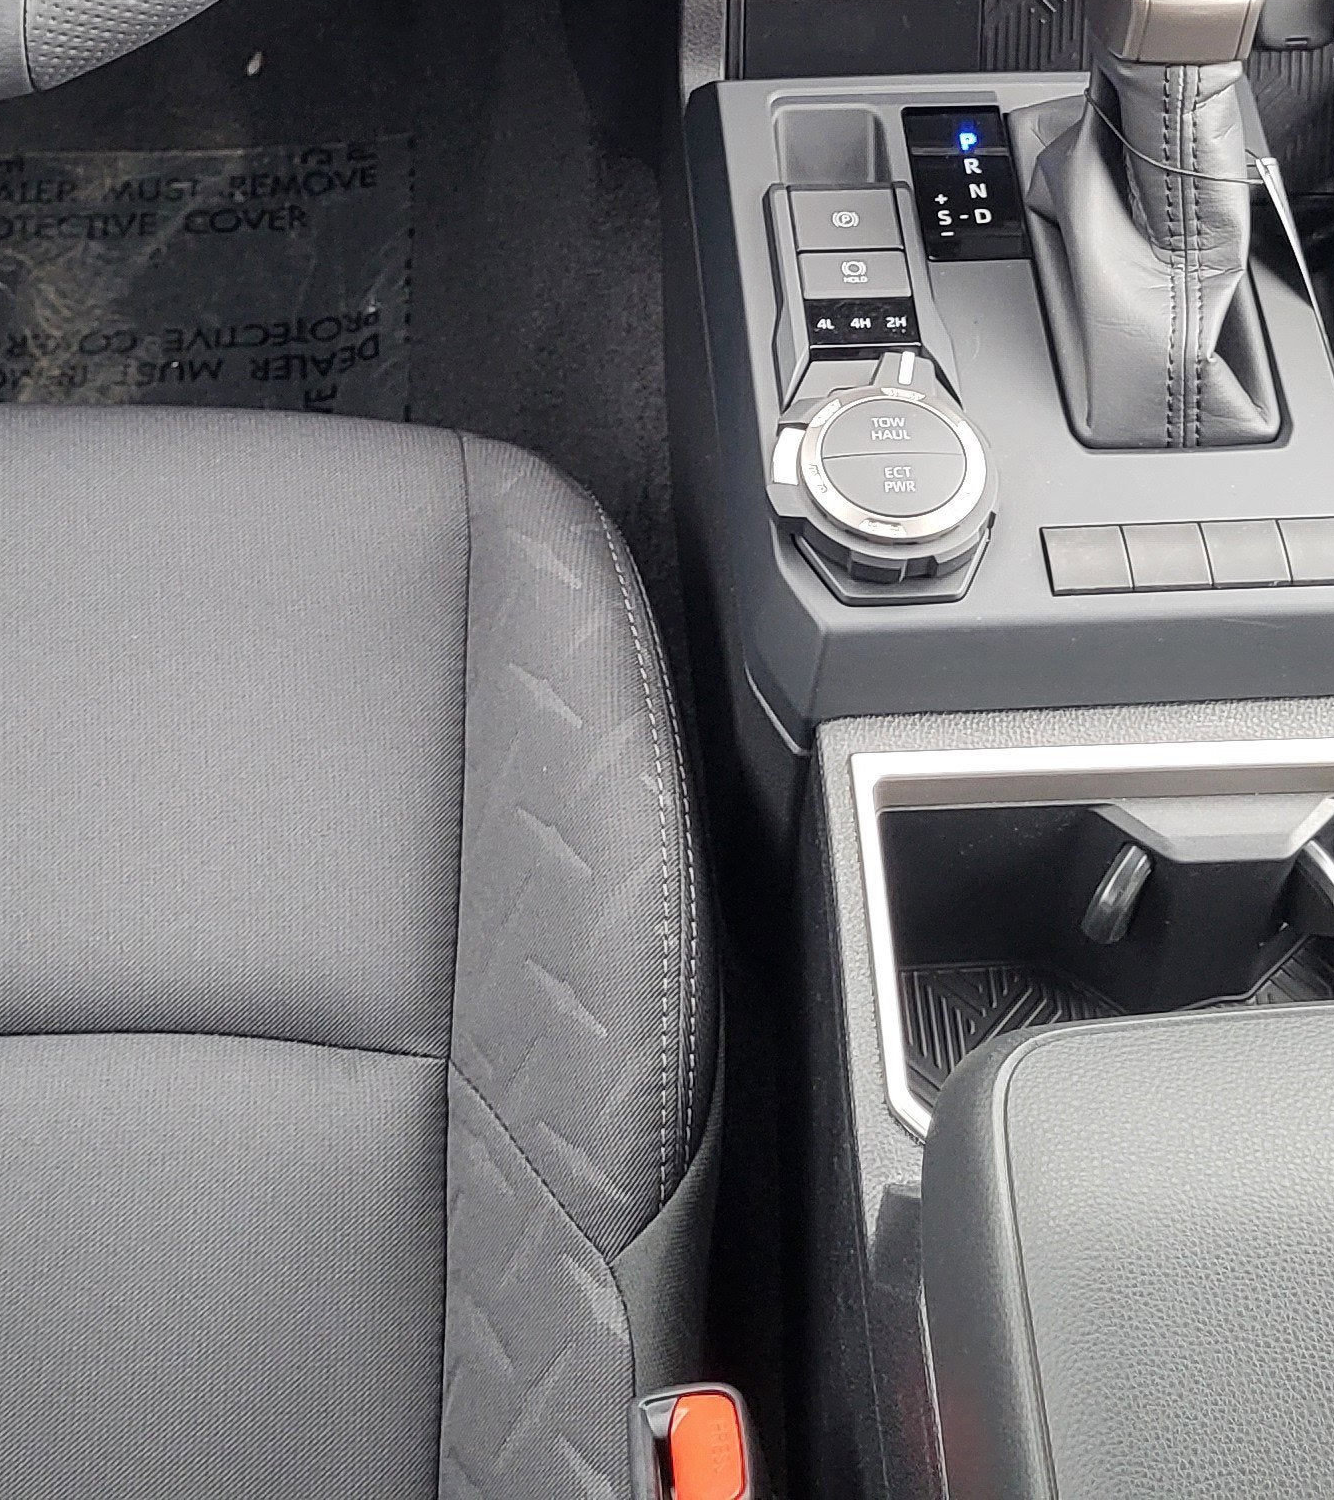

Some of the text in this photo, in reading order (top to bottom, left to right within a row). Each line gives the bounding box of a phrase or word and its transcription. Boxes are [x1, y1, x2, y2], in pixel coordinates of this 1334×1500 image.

[958, 131, 978, 152] P
[963, 157, 983, 175] R
[222, 164, 379, 200] REMOVE
[968, 182, 988, 199] N
[181, 203, 310, 237] COVER
[936, 207, 992, 226] S D
[842, 275, 869, 284] HOLD
[816, 315, 908, 331] 4L 4H 2H
[870, 416, 906, 429] TOW
[870, 428, 912, 442] HAUL
[883, 465, 913, 479] ECT
[883, 480, 917, 494] PWR
